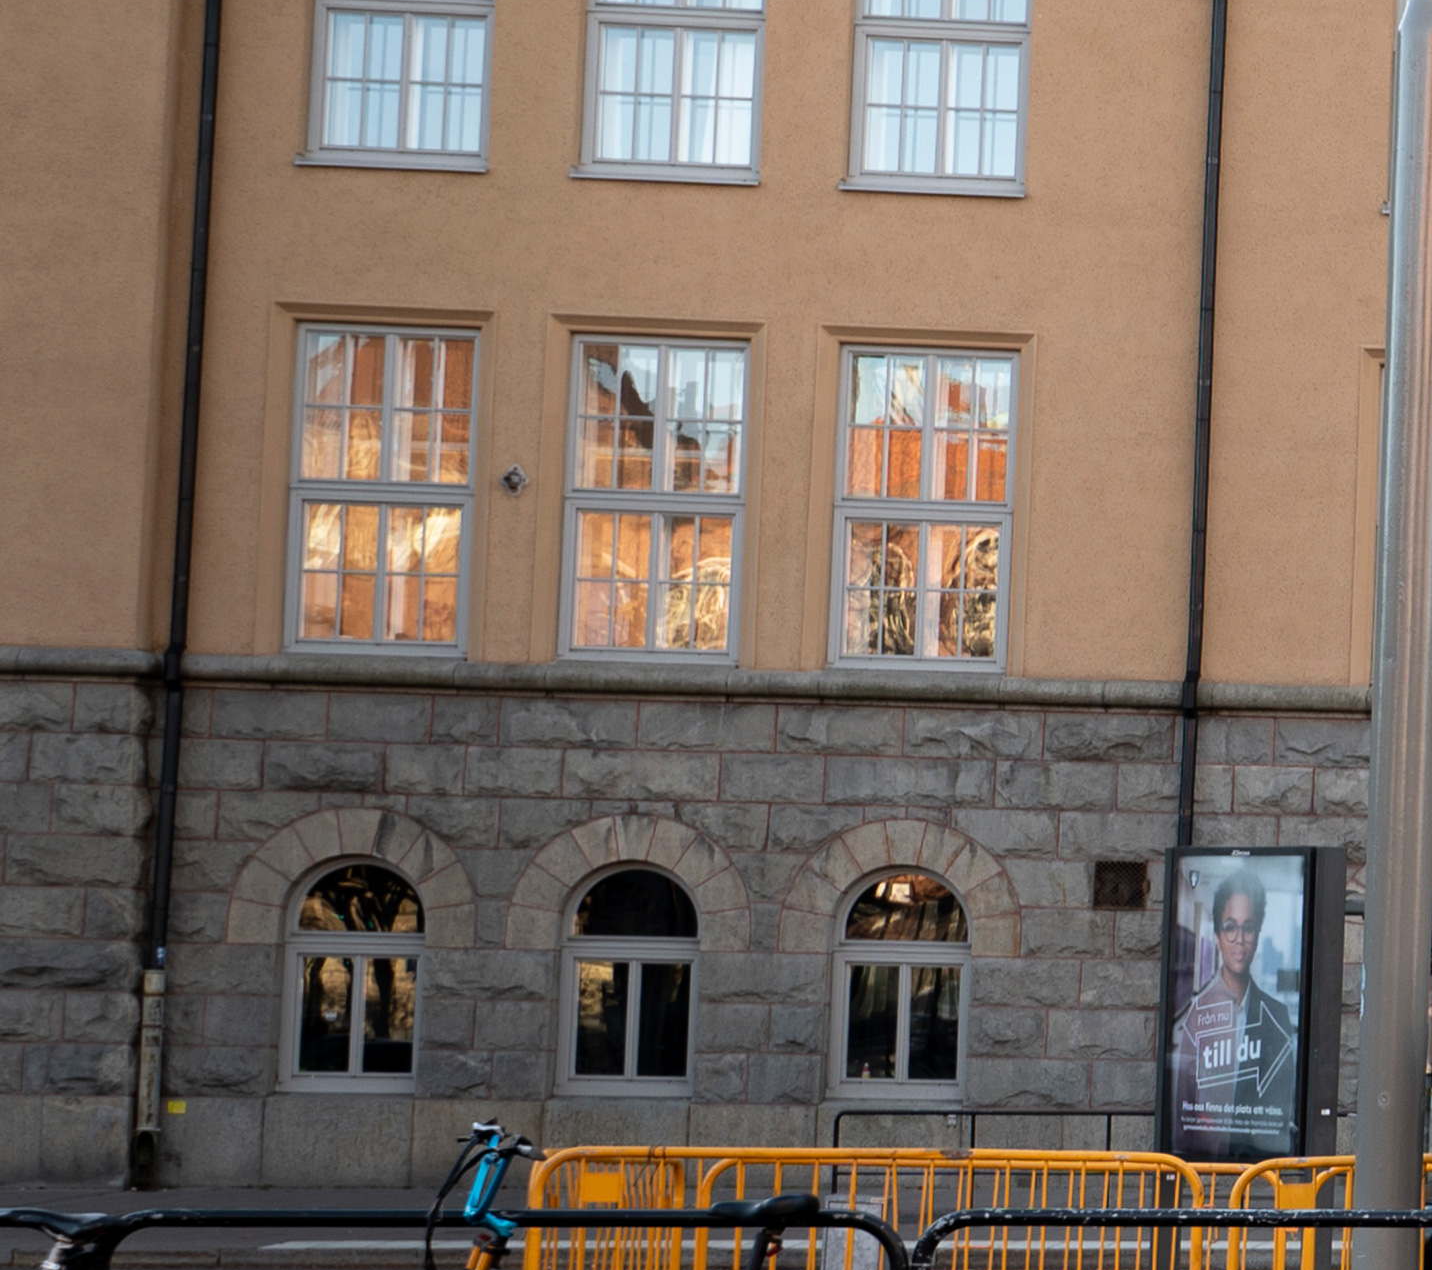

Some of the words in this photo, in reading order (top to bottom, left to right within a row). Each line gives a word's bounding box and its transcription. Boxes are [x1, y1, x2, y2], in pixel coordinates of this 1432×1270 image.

[1197, 1012, 1217, 1027] Från
[1217, 1012, 1230, 1022] nu
[1203, 1039, 1232, 1069] till
[1236, 1034, 1262, 1062] du
